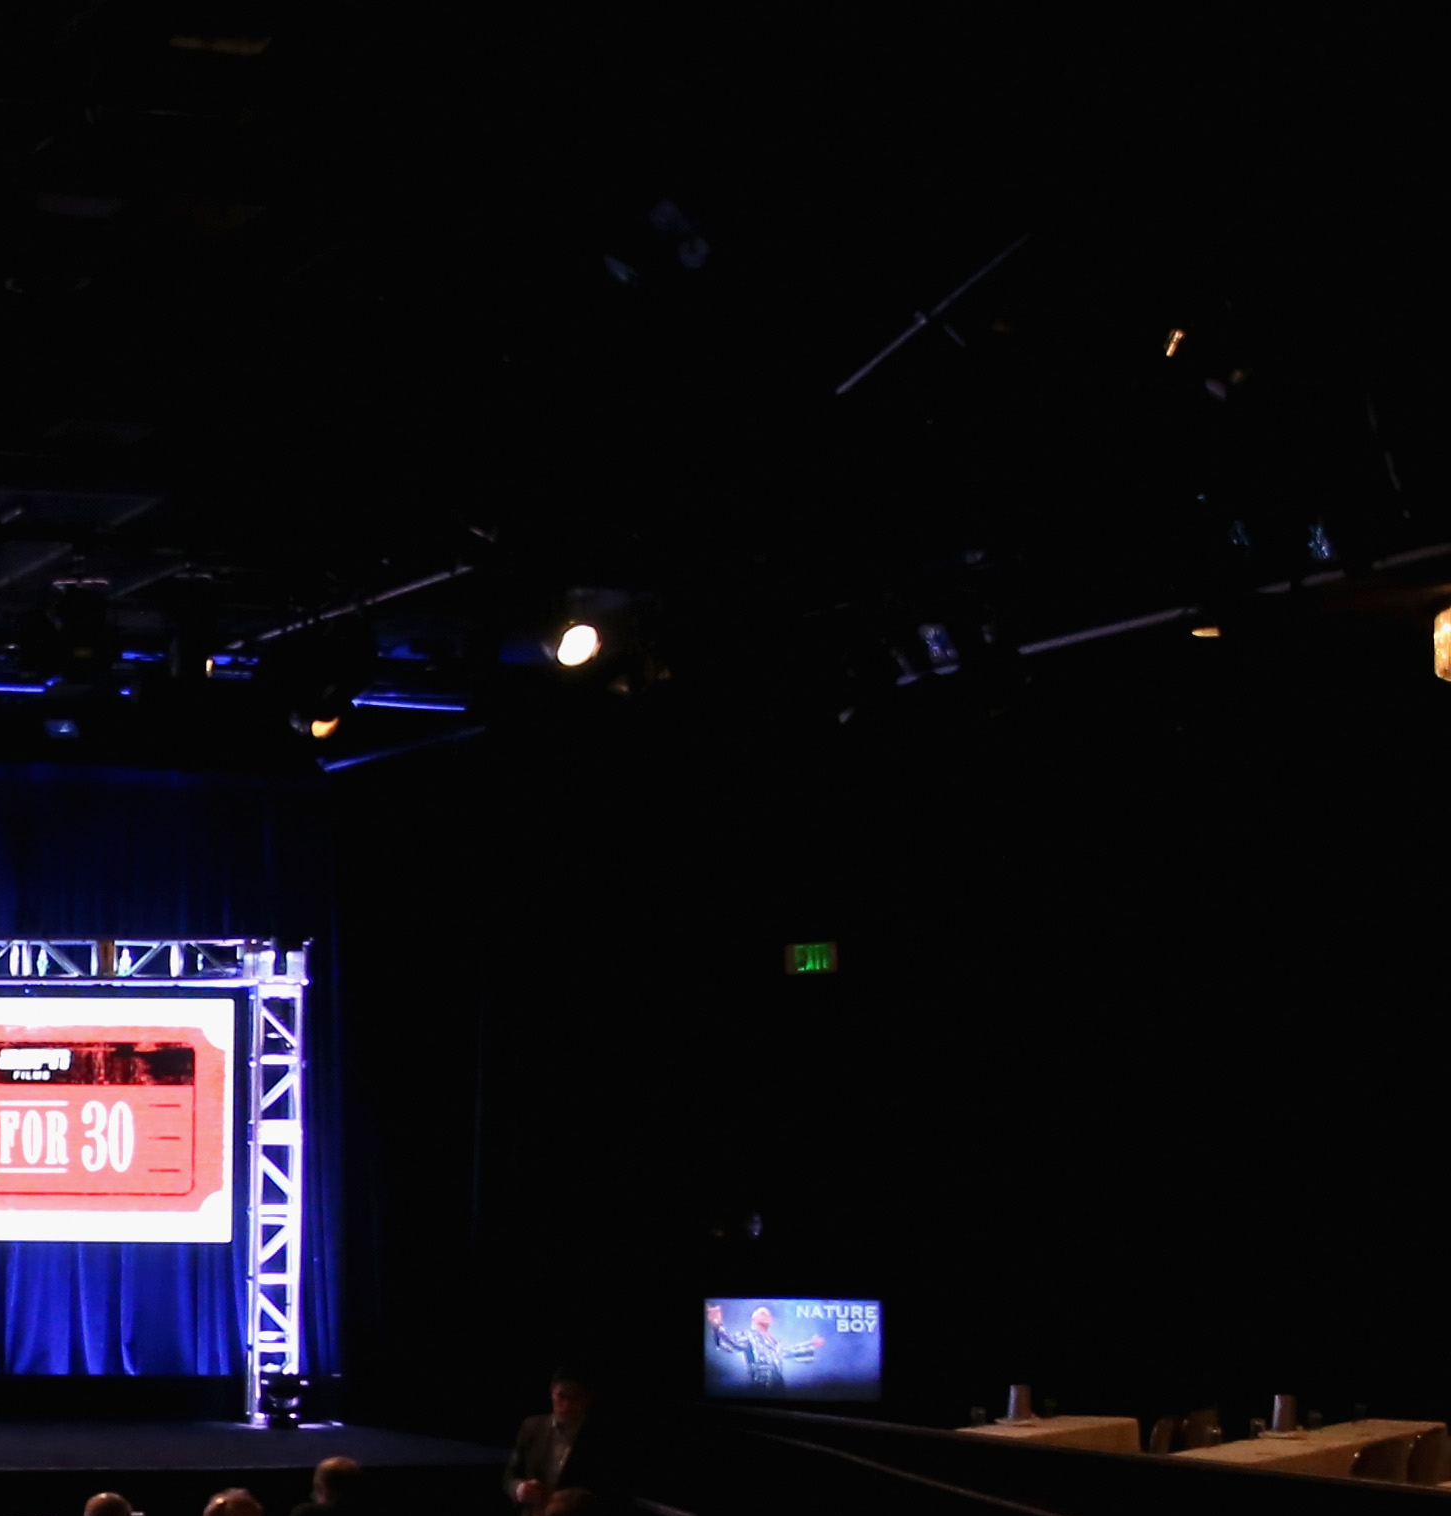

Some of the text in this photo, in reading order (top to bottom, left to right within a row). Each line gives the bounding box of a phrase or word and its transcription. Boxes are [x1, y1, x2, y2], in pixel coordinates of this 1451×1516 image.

[0, 1110, 69, 1165] FOR
[81, 1100, 135, 1173] 30
[795, 1305, 878, 1319] NATURE
[836, 1319, 877, 1332] BOY
